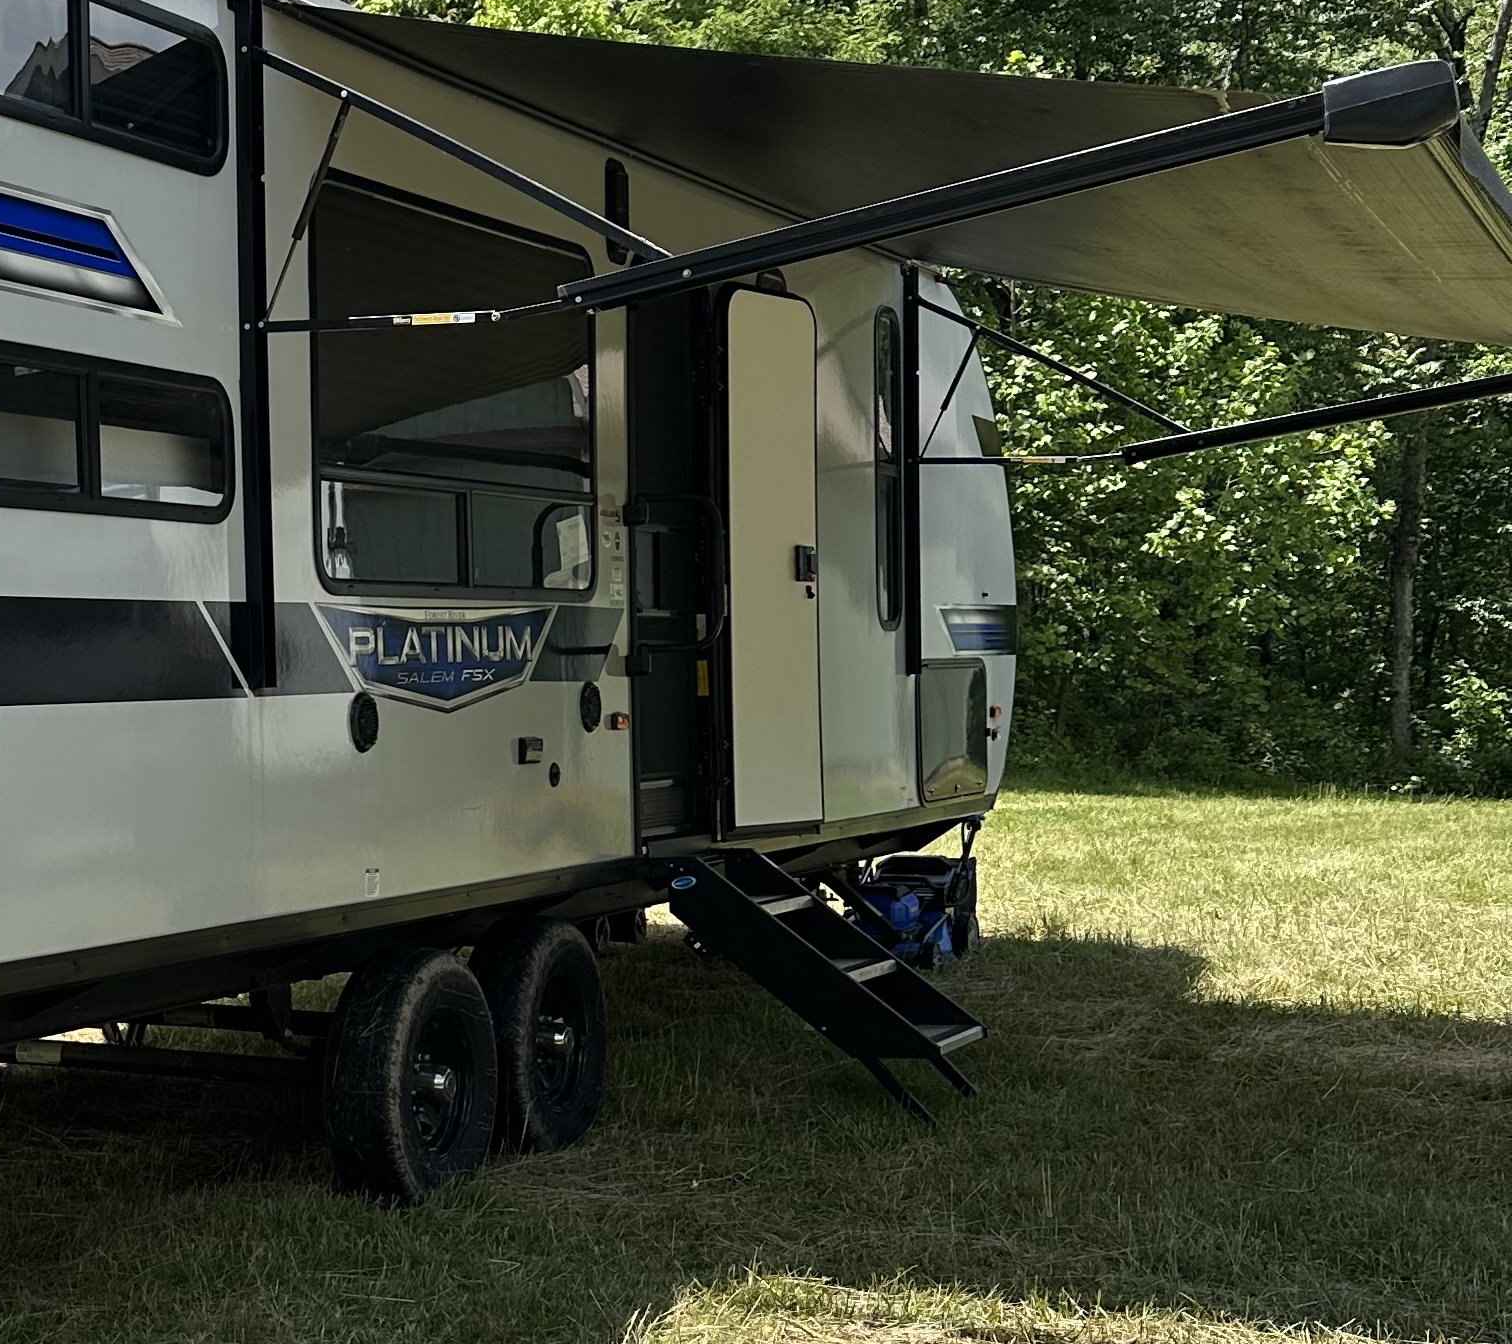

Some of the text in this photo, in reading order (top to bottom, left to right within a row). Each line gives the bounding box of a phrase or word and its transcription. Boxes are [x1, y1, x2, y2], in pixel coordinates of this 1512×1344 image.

[348, 625, 532, 666] PLATINUM
[397, 668, 497, 685] SALEM FSX
